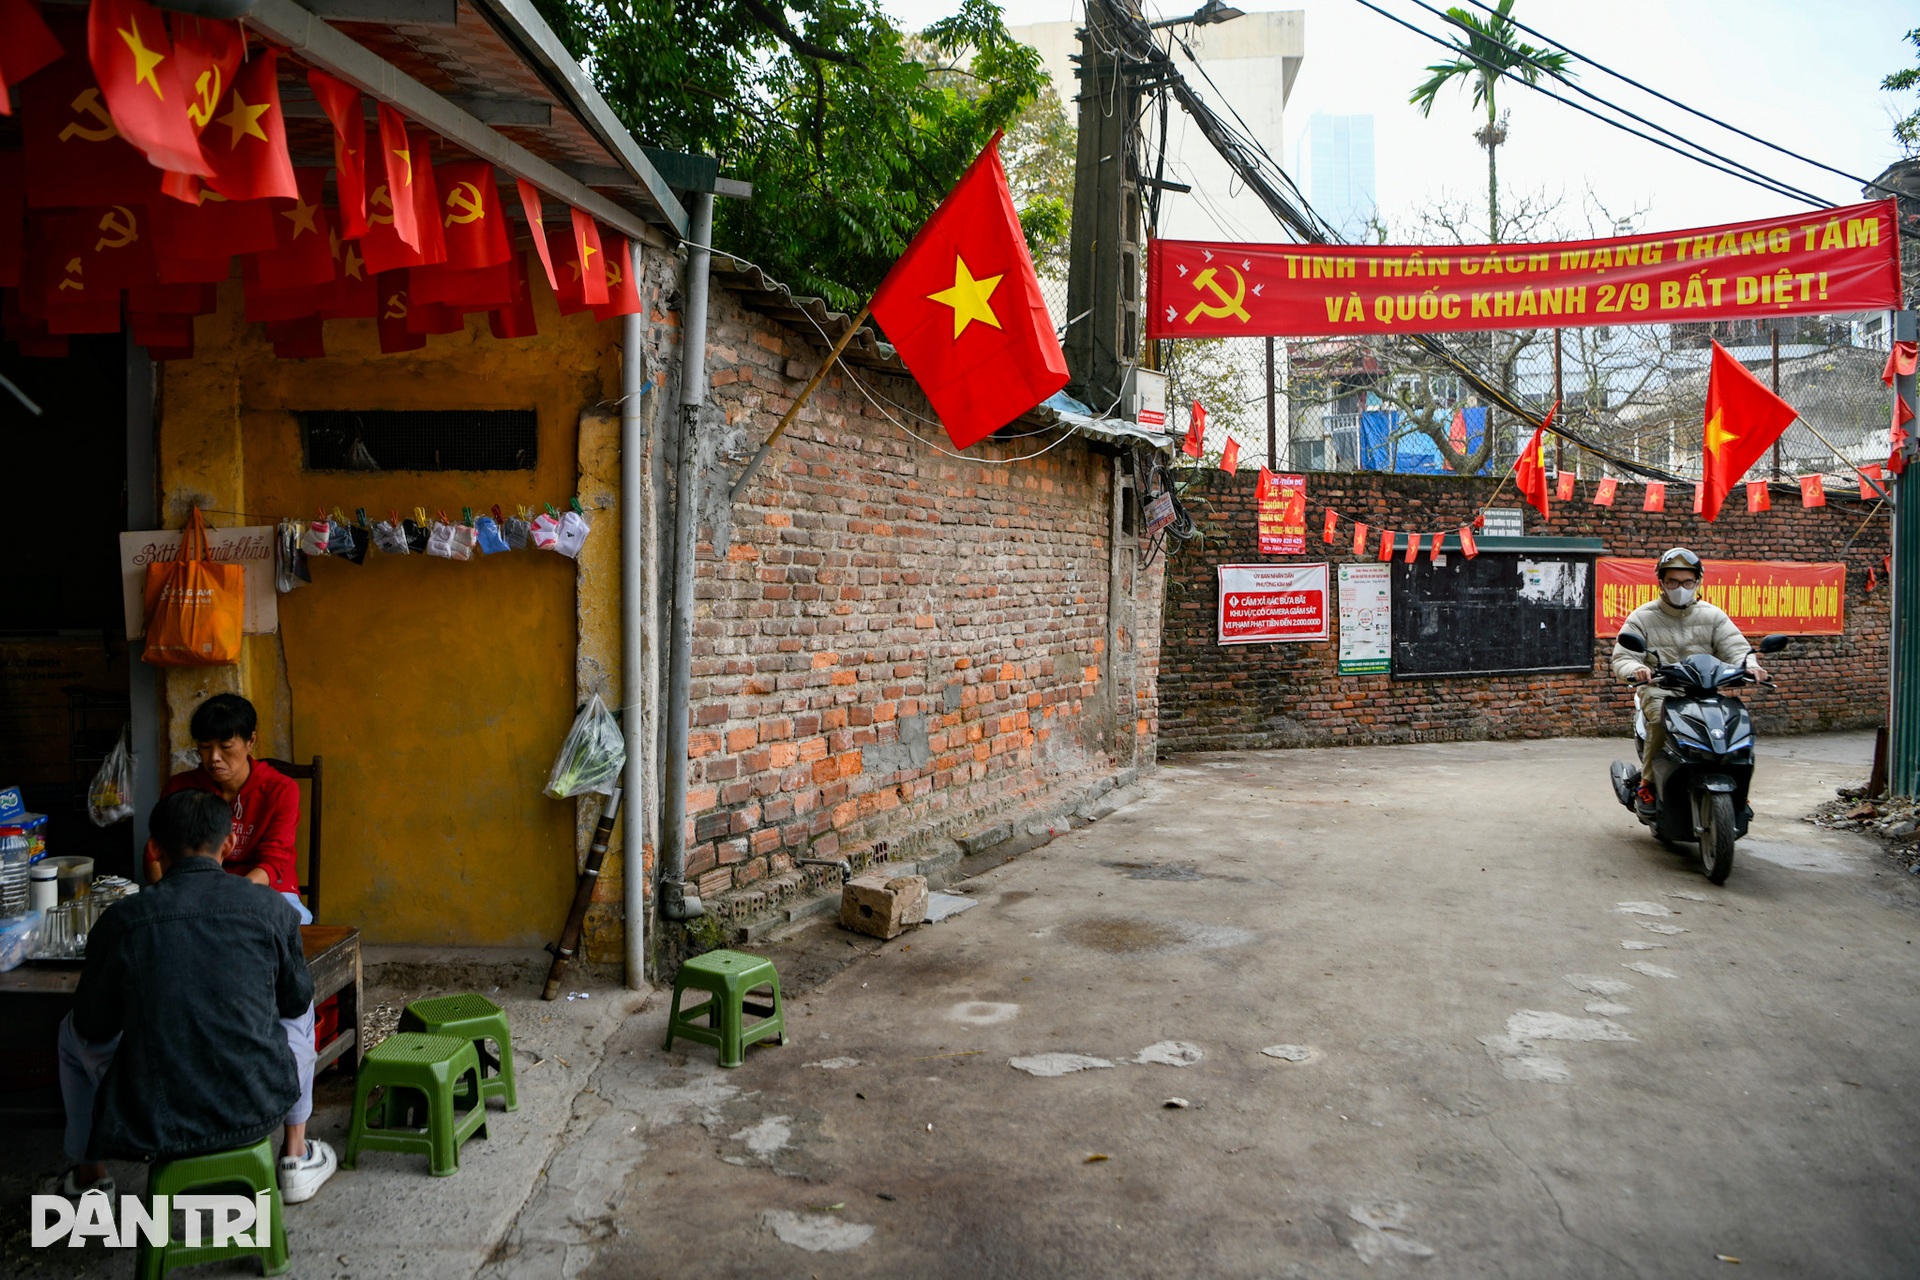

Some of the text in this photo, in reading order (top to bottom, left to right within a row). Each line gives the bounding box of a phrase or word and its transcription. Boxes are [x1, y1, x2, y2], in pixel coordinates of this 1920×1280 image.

[1366, 250, 1450, 278] THẦN
[1460, 250, 1550, 275] CÁCH
[1560, 242, 1664, 274] MẠNG
[1673, 230, 1792, 262] THÁNG
[1800, 217, 1880, 251] TÁM
[1325, 268, 1829, 324] VÀ QUỐC KHÁNH 2/9 BẤT DIỆT!
[1229, 609, 1244, 617] KHU
[1256, 606, 1266, 616] CÓ
[1266, 607, 1290, 615] CAMERA
[1289, 605, 1306, 615] GIÁM
[1306, 604, 1317, 613] SÁT
[1241, 595, 1257, 606] CẤM
[1602, 583, 1618, 625] GỌI
[1618, 585, 1635, 617] 114
[1635, 584, 1651, 609] KHI
[1728, 571, 1741, 618] NỔ
[1740, 578, 1762, 625] HOẶC
[1778, 579, 1795, 617] CỨU
[1812, 579, 1828, 617] CỨU
[1827, 579, 1839, 624] HỘ
